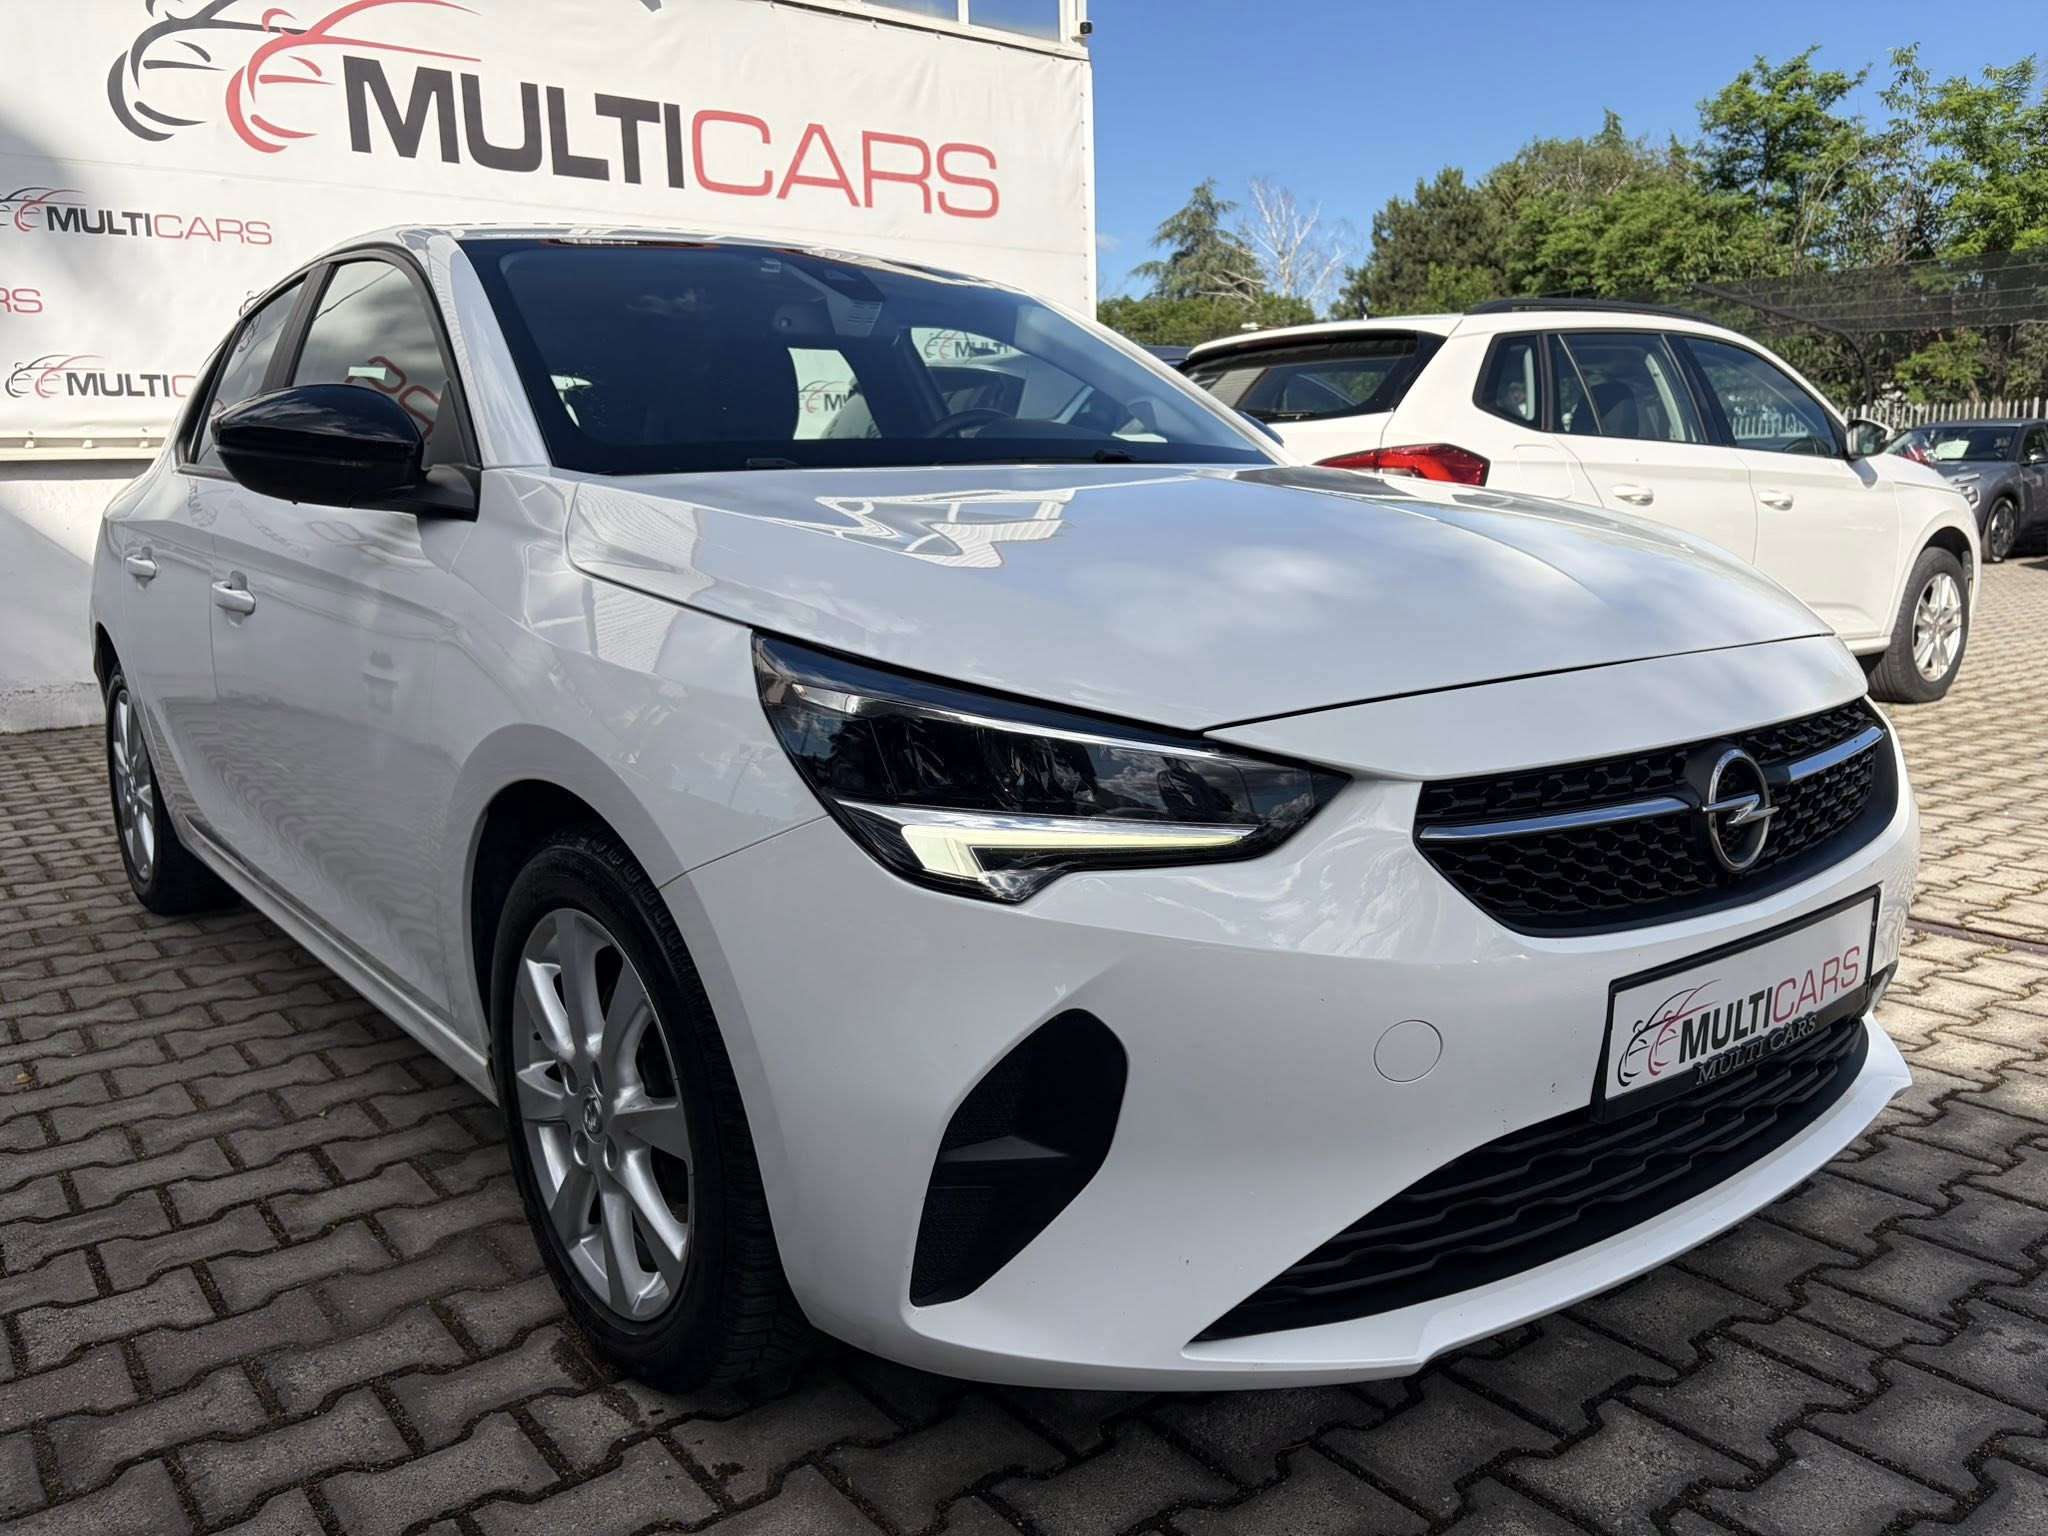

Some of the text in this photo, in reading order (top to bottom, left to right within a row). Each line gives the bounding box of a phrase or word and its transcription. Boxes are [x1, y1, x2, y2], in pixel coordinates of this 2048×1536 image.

[343, 55, 1000, 219] MULTICARS
[46, 205, 273, 246] MULTICARS
[1678, 945, 1860, 1064] MULTICARS
[1695, 1013, 1817, 1086] MULTI CARS
